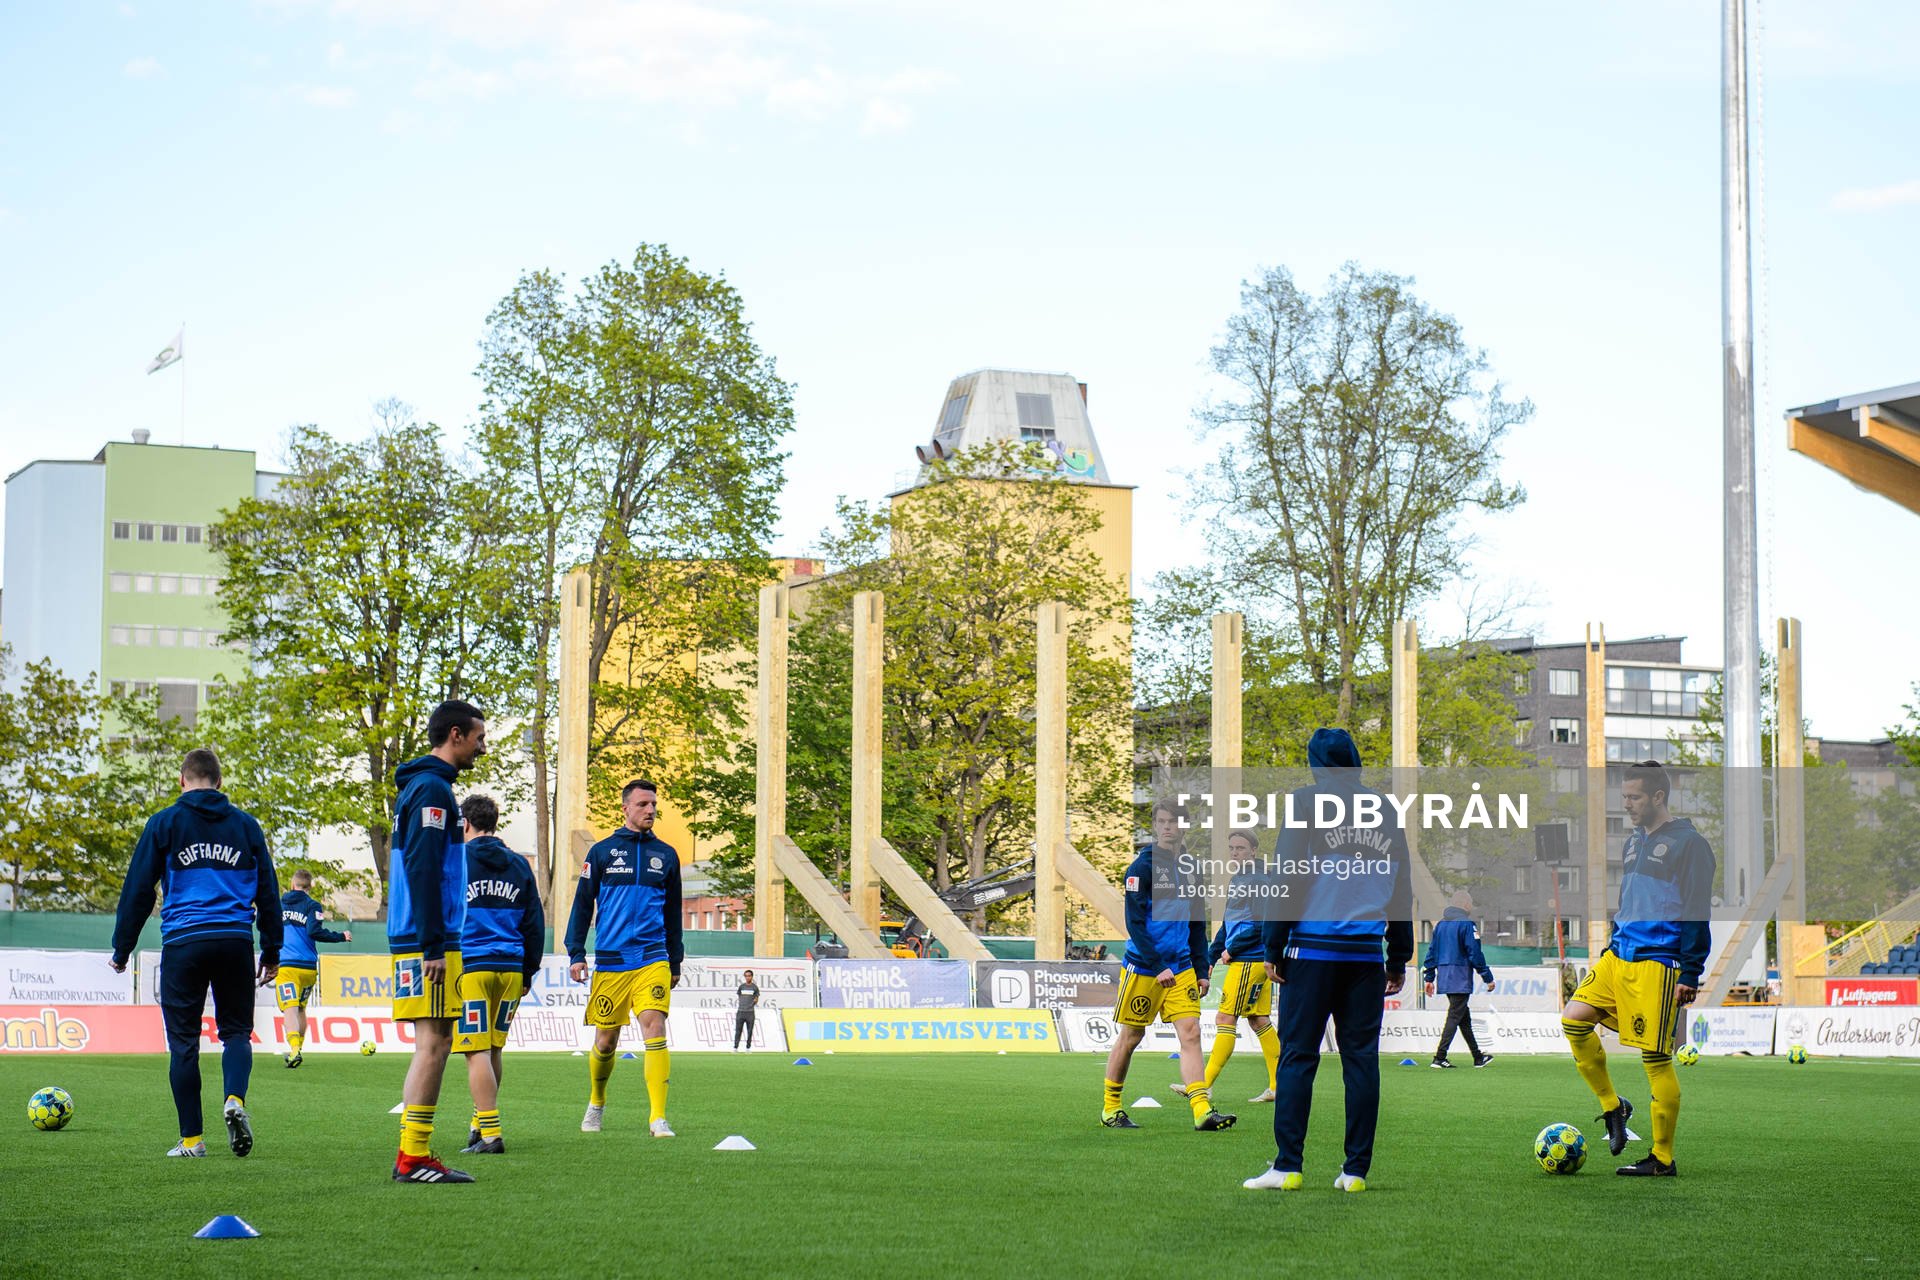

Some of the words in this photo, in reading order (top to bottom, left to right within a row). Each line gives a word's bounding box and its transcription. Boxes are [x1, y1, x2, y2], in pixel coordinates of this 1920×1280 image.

[1324, 825, 1392, 855] GIFFARNA
[178, 843, 241, 866] GIFFARNA
[606, 866, 633, 874] stadium
[783, 975, 807, 989] AB
[1034, 969, 1112, 984] Phosworks
[1034, 983, 1079, 1000] Digital
[1842, 987, 1898, 1004] Luthagens
[838, 1021, 1049, 1040] SYSTEMSVETS
[1379, 1026, 1441, 1038] CASTELLU
[1496, 1027, 1565, 1039] CASTELLU
[1692, 1021, 1709, 1043] GK
[1816, 1017, 1892, 1046] Andersson
[1895, 1023, 1909, 1046] &
